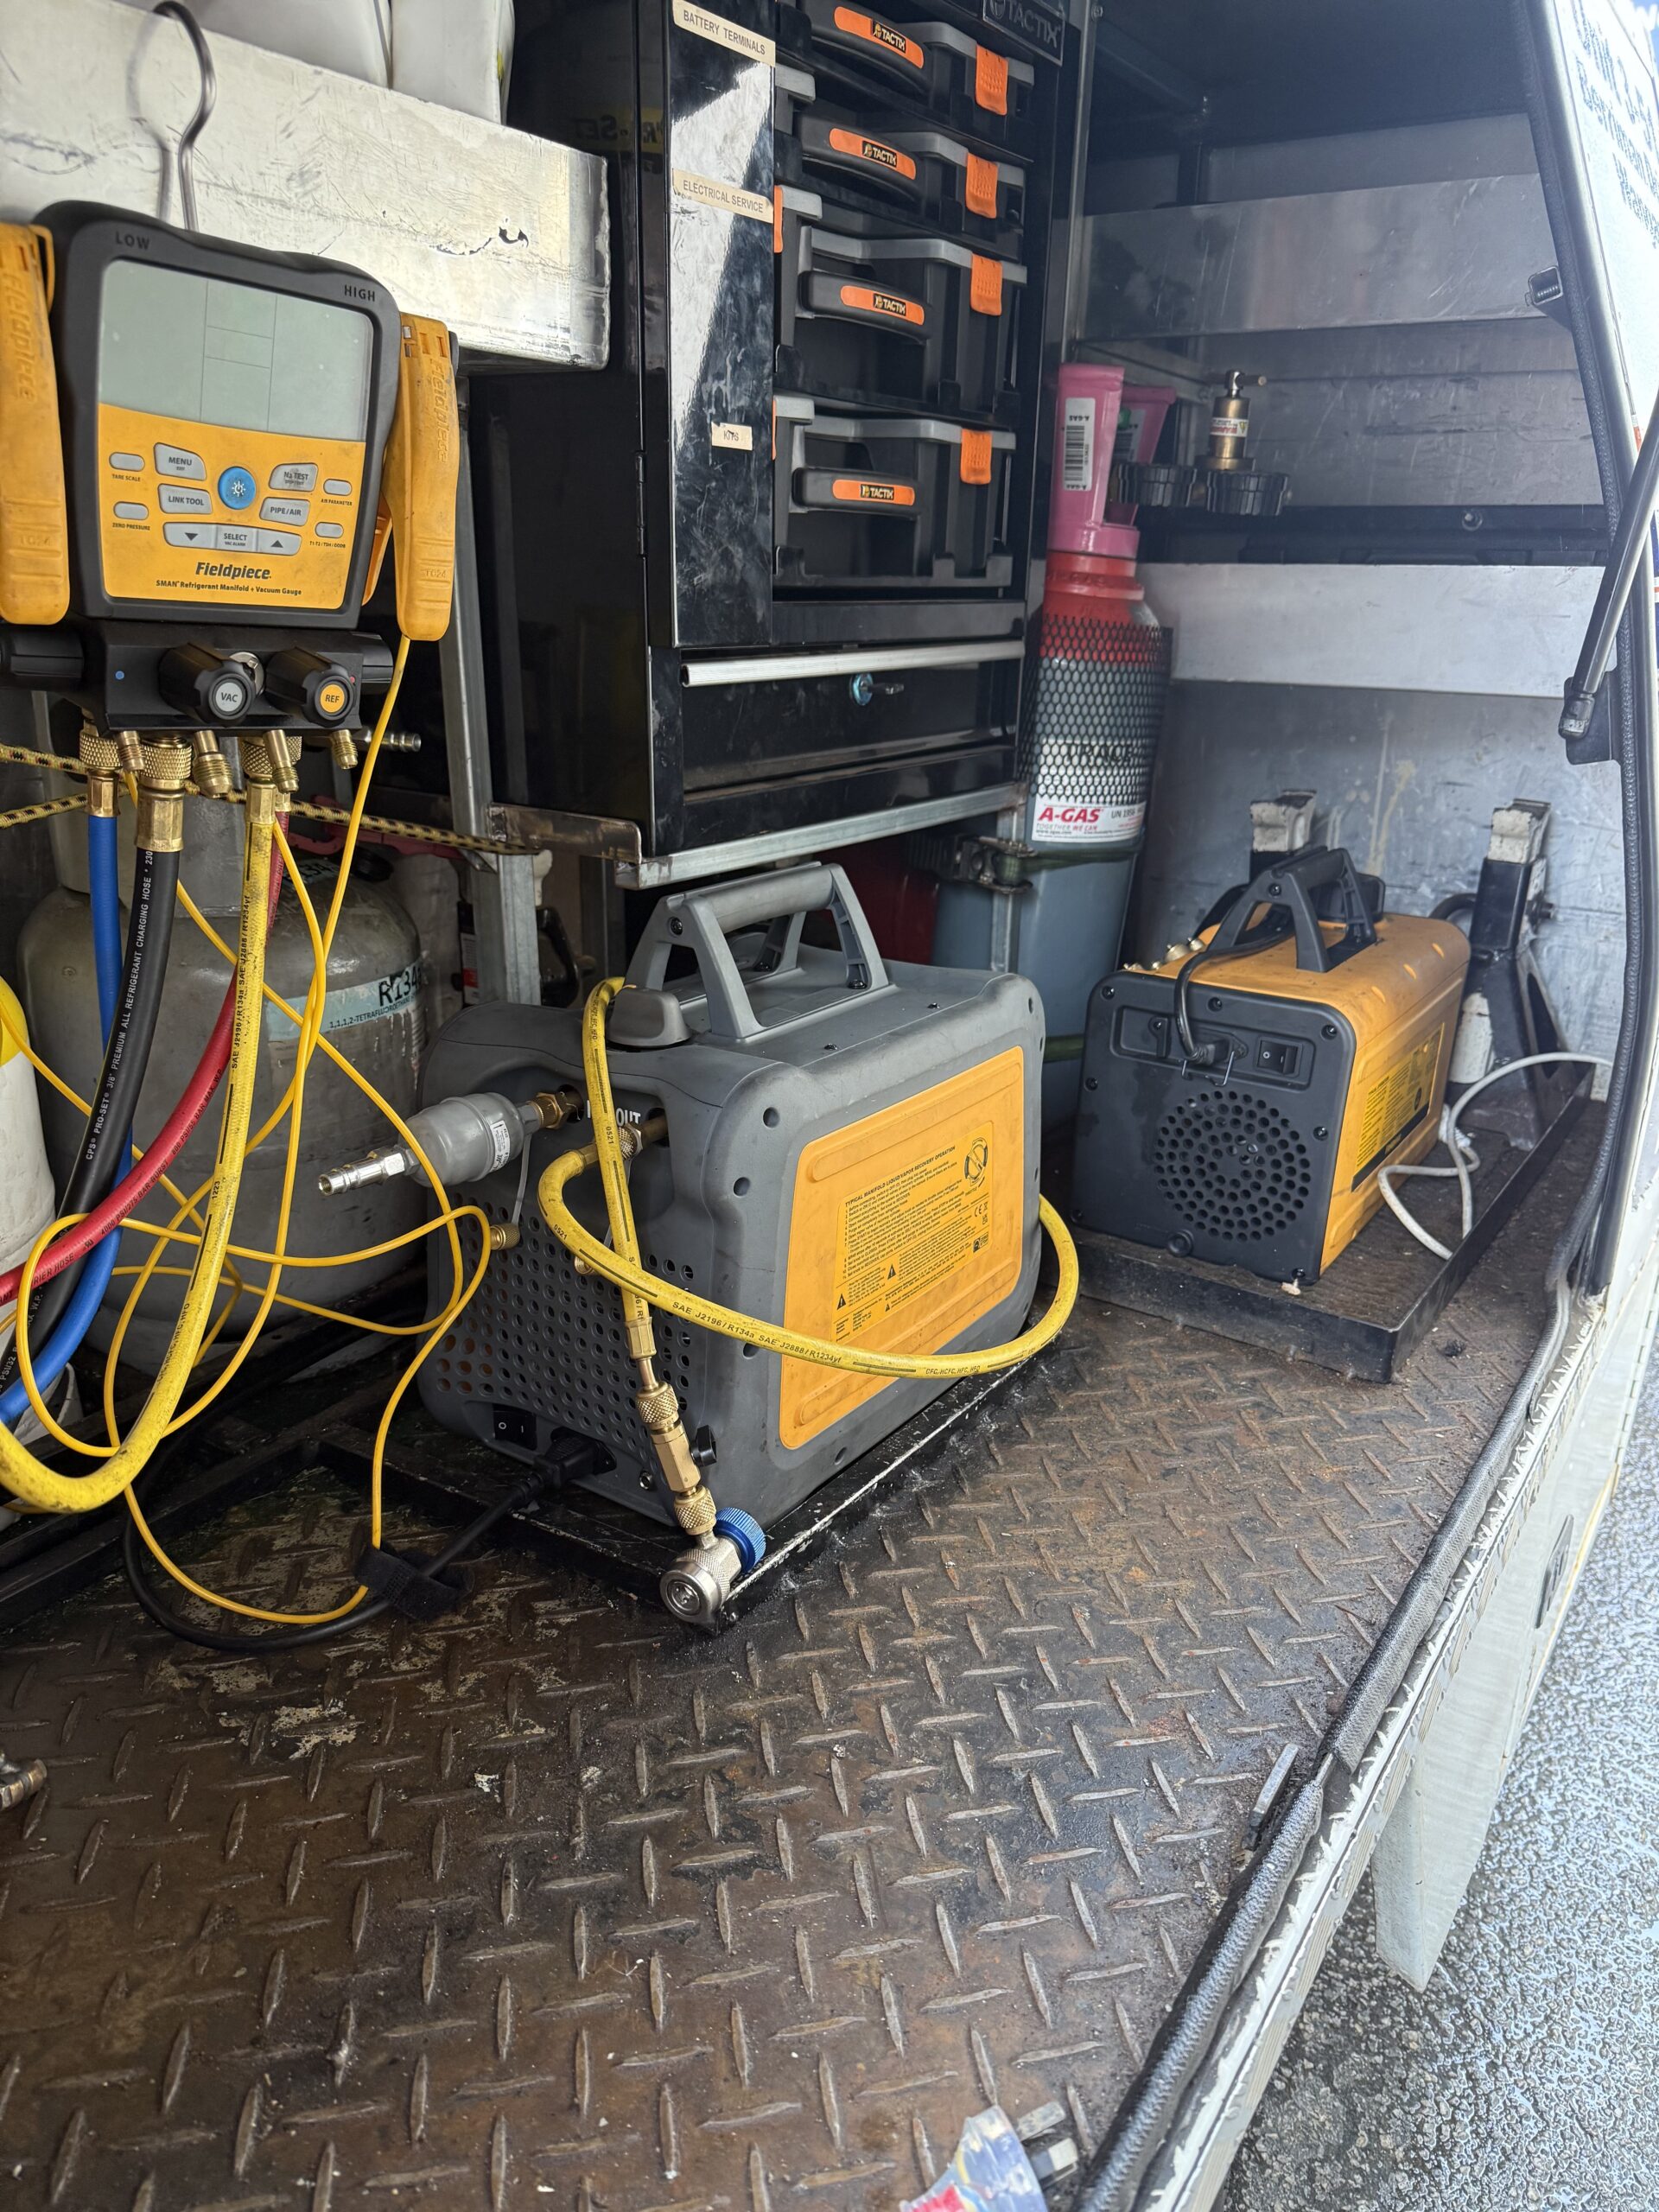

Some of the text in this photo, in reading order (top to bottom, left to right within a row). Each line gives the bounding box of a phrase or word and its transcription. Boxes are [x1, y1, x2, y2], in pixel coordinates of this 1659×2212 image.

[683, 10, 766, 55] BATTERY TERMINALS
[880, 28, 906, 51] TACTIX
[872, 148, 897, 165] TACTIX
[683, 180, 764, 213] ELECTRICAL SERVICE
[115, 231, 150, 250] LOW
[344, 284, 376, 302] HIGH
[882, 300, 906, 315] TACTIX
[168, 456, 193, 466] MENU
[294, 472, 309, 480] TEST
[168, 495, 205, 505] LINK TOOL
[869, 487, 893, 499] TACTIX
[223, 532, 248, 542] SELECT
[195, 562, 272, 581] Fieldpiece
[180, 581, 219, 592] Refrigerant
[219, 583, 249, 592] Manifold
[256, 586, 281, 594] Vacuum
[282, 588, 302, 596] Gauge
[220, 692, 238, 702] VAC
[325, 694, 340, 703] REF
[1038, 807, 1101, 823] A-GAS
[1111, 810, 1122, 819] UN
[1036, 823, 1071, 831] TOGETHER
[141, 876, 152, 900] HOSE
[135, 903, 149, 948] CHARGING
[124, 951, 143, 1011] REFRIGERANT
[123, 1011, 131, 1029] ALL
[111, 1031, 127, 1071] PREMIUM
[194, 1104, 206, 1121] BAR
[616, 1108, 641, 1127] OUT
[606, 1126, 614, 1145] 0521
[137, 1182, 151, 1198] BAR
[150, 1160, 168, 1183] BURST
[845, 1195, 862, 1206] TYPICAL
[864, 1183, 886, 1198] MANIFOLD
[914, 1154, 934, 1170] RECOVERY
[934, 1145, 956, 1160] OPERATION
[212, 1180, 221, 1200] 1223
[554, 1224, 569, 1240] 0521
[54, 1252, 74, 1271] HOSE
[671, 1301, 692, 1315] SAE
[758, 1334, 778, 1346] SAE
